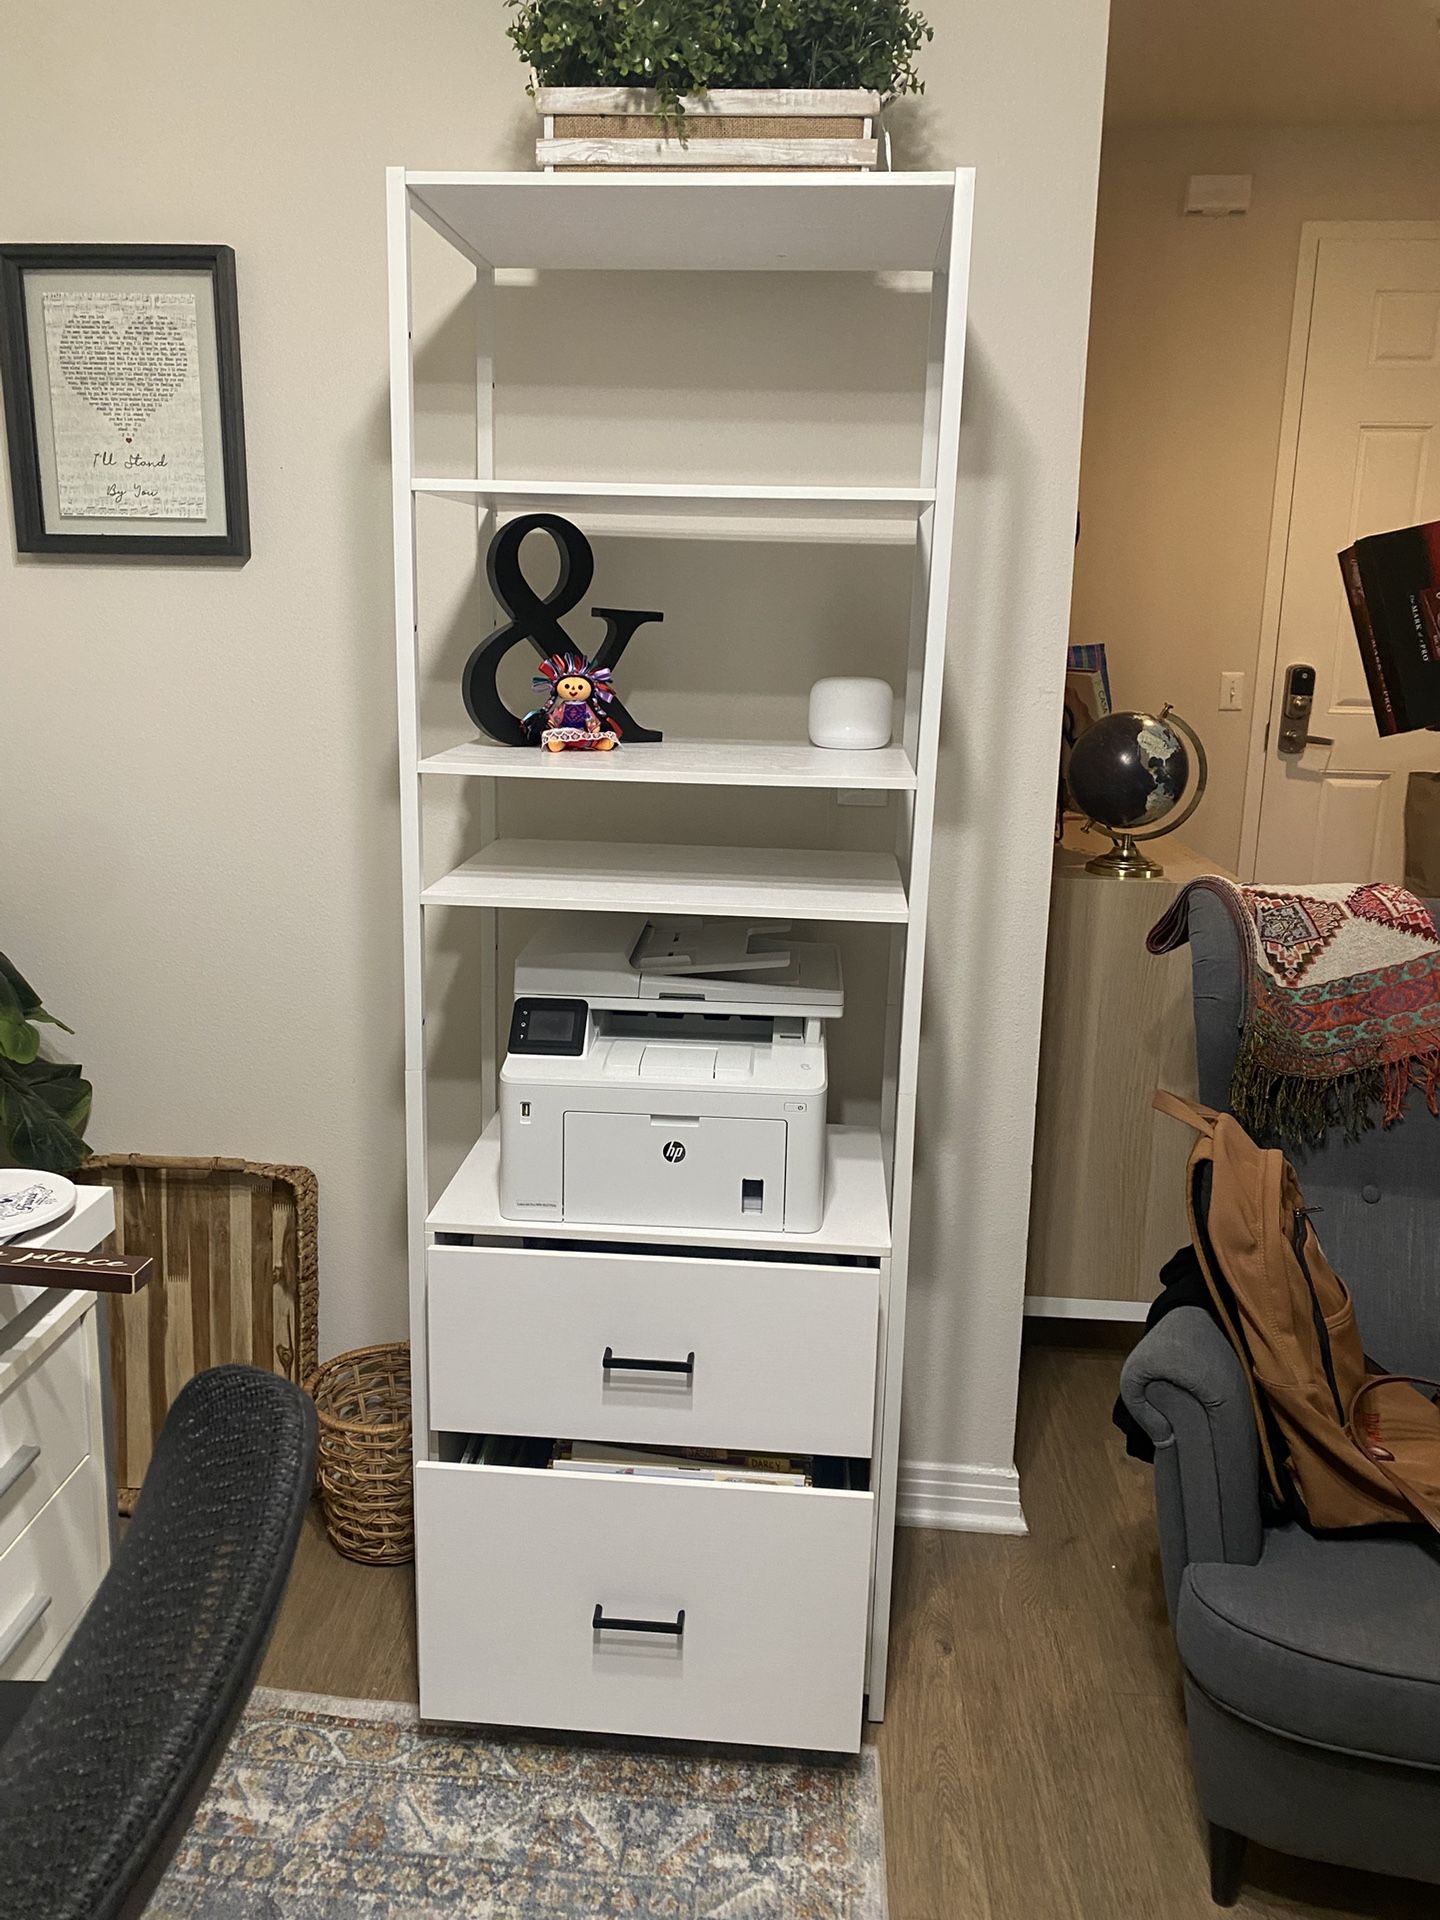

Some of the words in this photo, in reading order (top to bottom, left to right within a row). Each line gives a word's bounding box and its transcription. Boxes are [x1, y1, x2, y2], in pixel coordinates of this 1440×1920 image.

[93, 451, 117, 468] I'll
[124, 453, 168, 469] Stand
[107, 483, 127, 503] By
[134, 483, 158, 498] You
[1420, 643, 1430, 662] PRO
[664, 1140, 685, 1163] hp
[11, 1252, 128, 1267] place
[751, 1458, 782, 1471] DARCY
